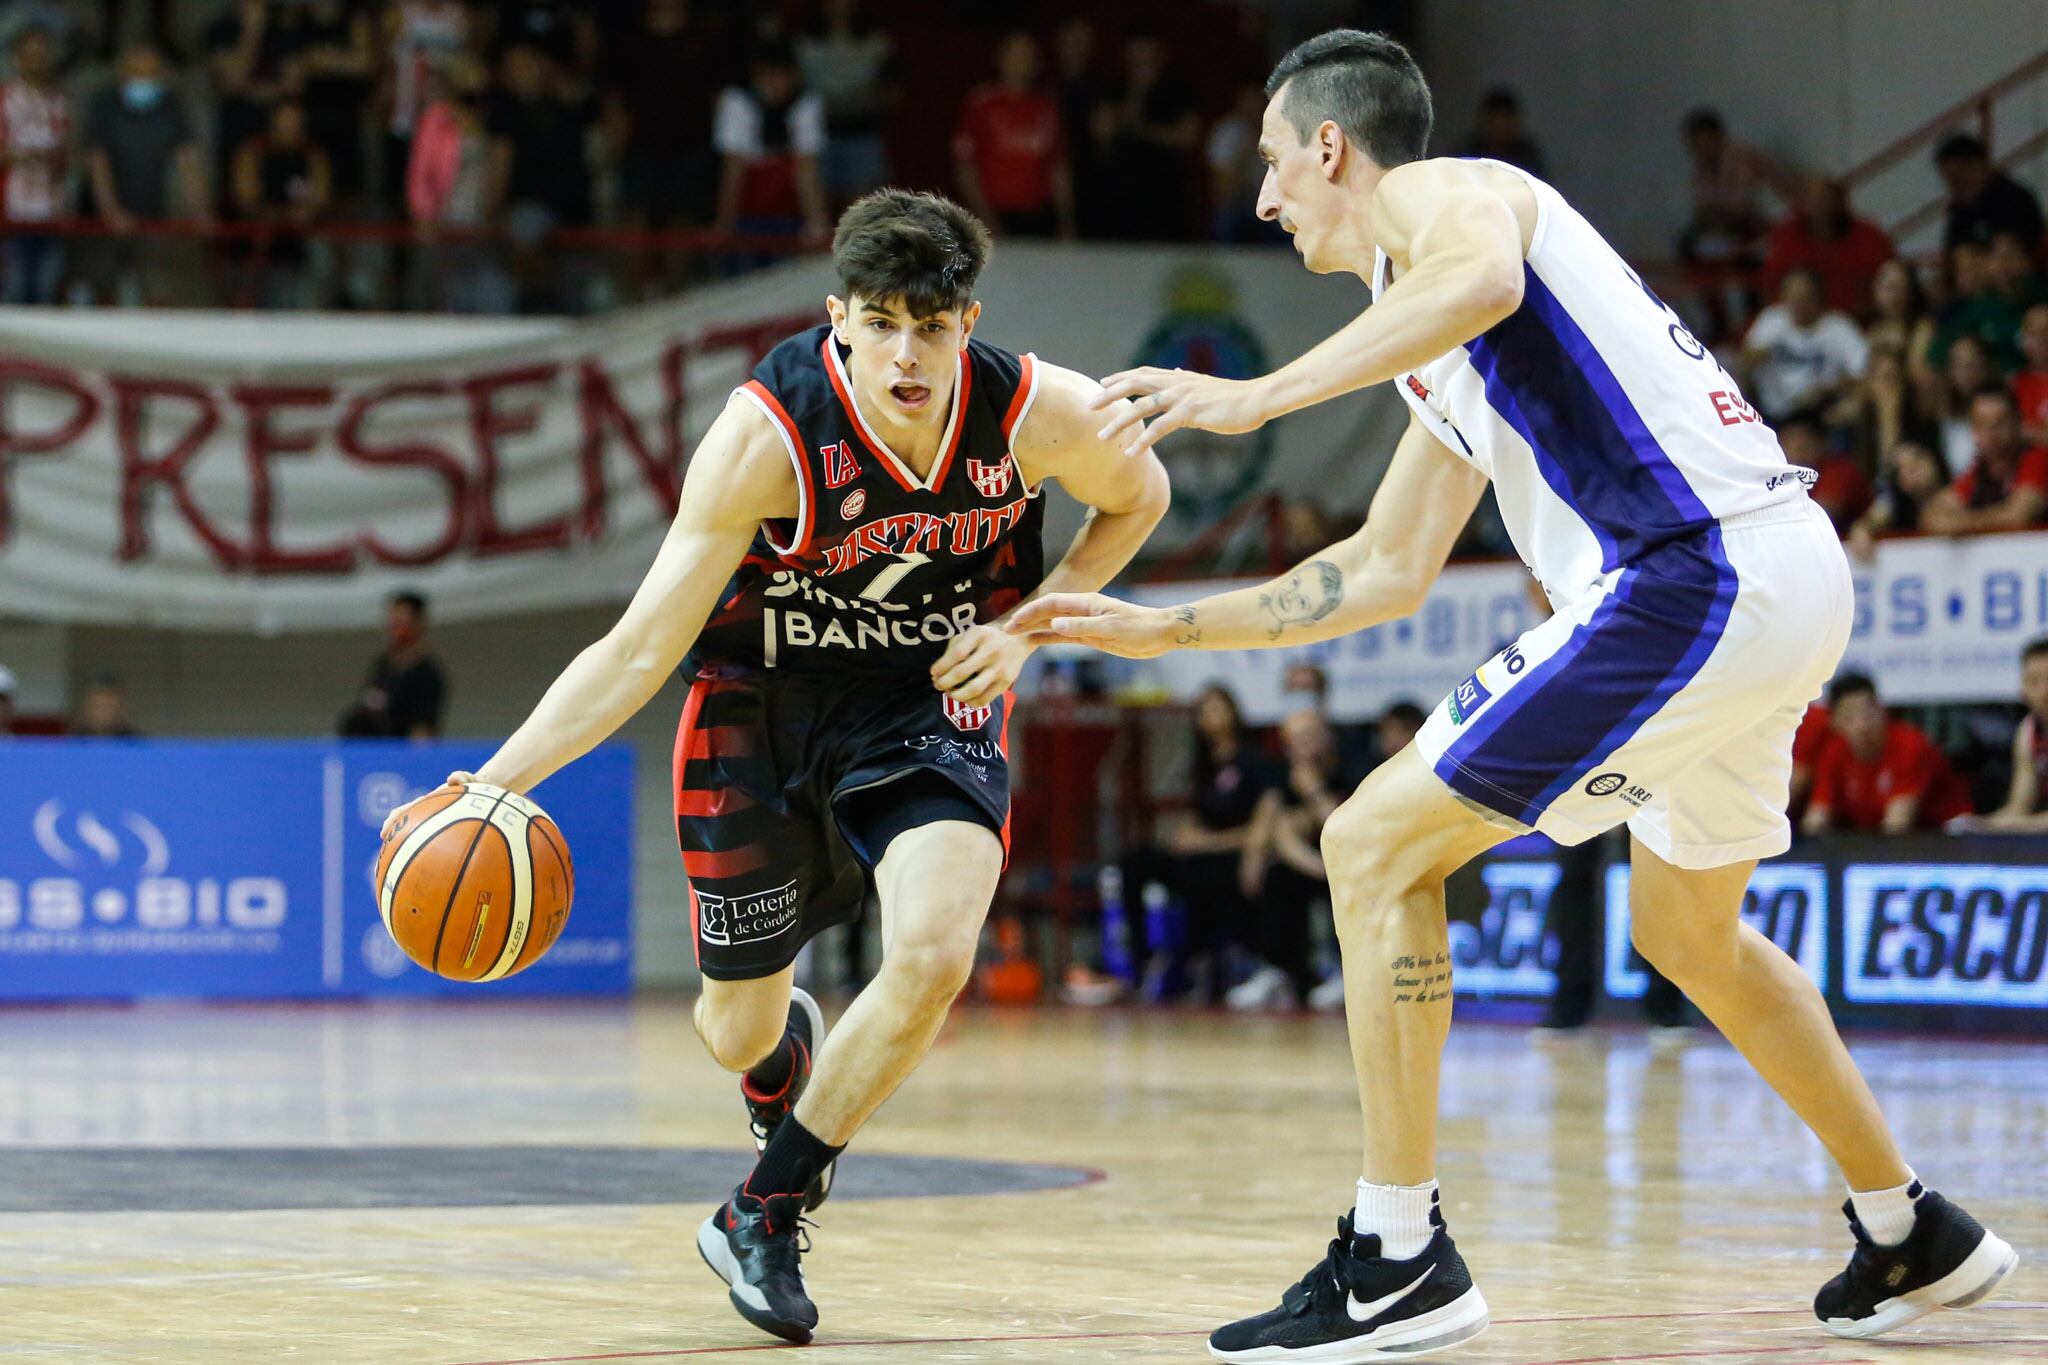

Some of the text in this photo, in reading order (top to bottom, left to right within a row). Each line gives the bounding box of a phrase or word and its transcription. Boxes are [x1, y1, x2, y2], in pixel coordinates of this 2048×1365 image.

[784, 602, 977, 650] BANCOR
[734, 922, 751, 935] de
[1861, 886, 2048, 984] ESCO
